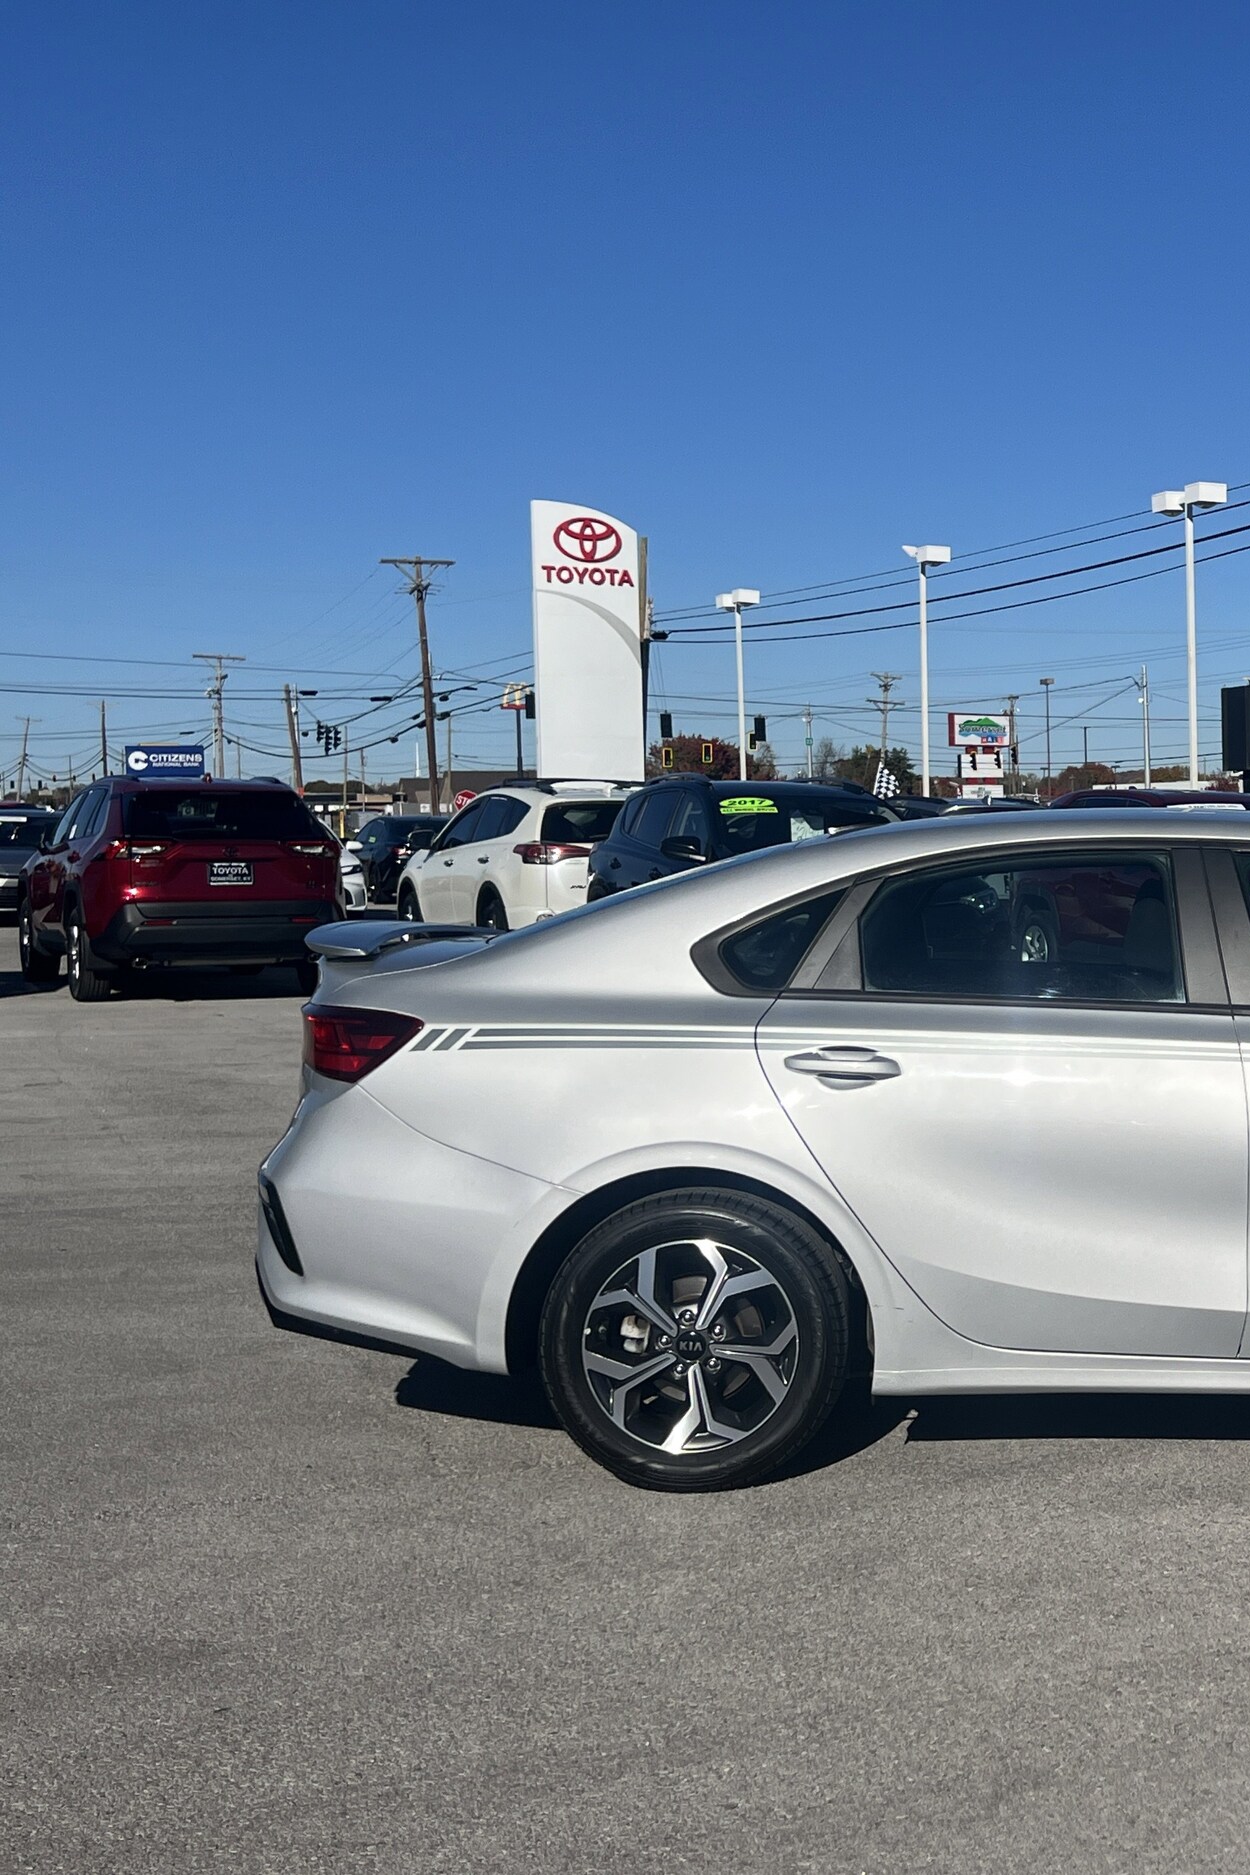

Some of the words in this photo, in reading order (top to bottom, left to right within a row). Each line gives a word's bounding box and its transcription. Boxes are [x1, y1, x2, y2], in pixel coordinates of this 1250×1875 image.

[541, 565, 634, 587] TOYOTA
[149, 754, 202, 762] CITIZENS
[212, 867, 249, 875] TOYOTA
[679, 1341, 702, 1352] KIA
